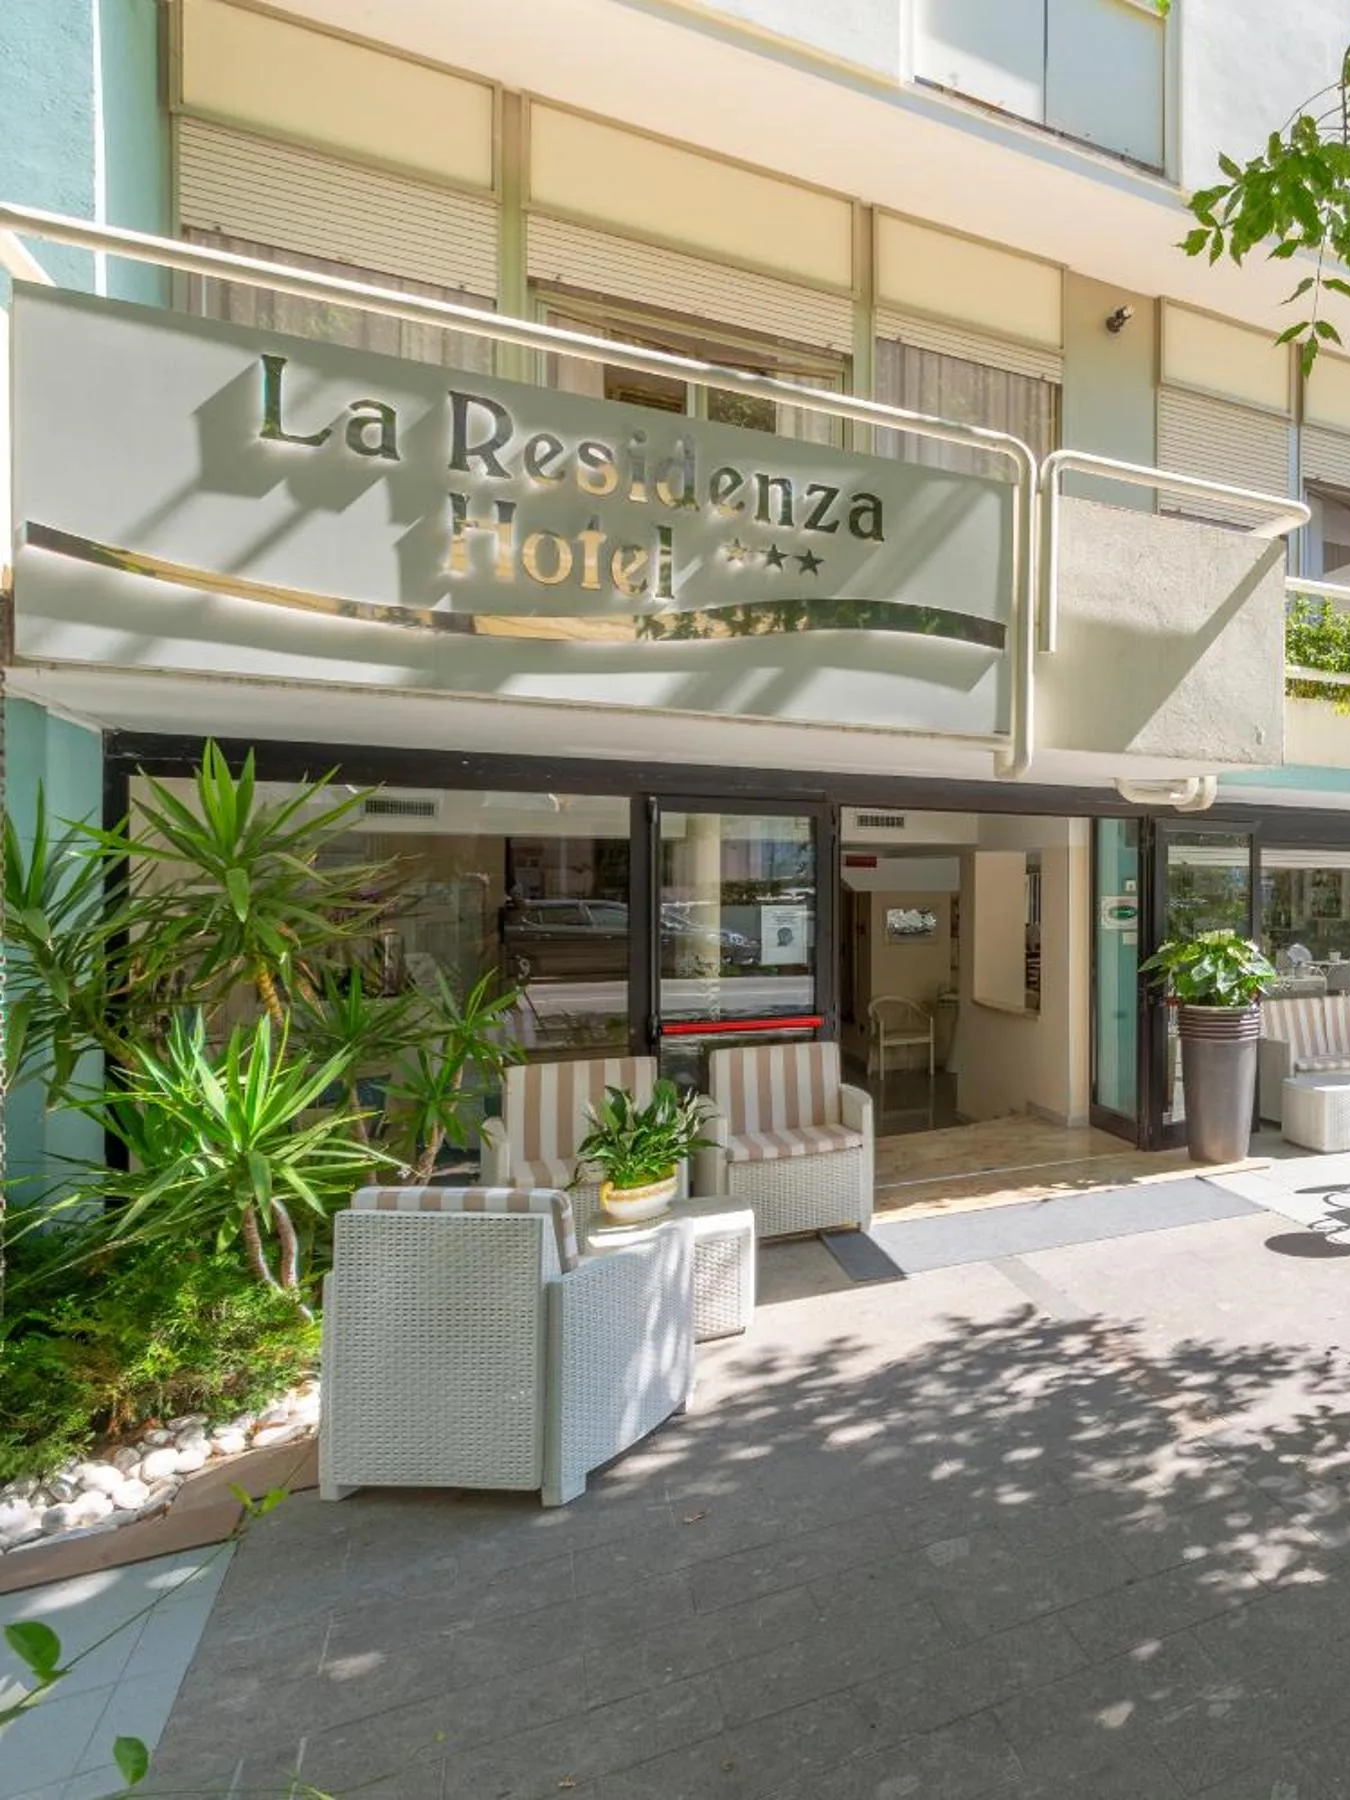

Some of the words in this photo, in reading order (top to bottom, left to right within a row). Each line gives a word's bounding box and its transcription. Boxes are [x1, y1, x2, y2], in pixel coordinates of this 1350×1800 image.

[259, 354, 401, 461] La
[448, 390, 885, 542] Residenza
[446, 492, 675, 600] Hotel
